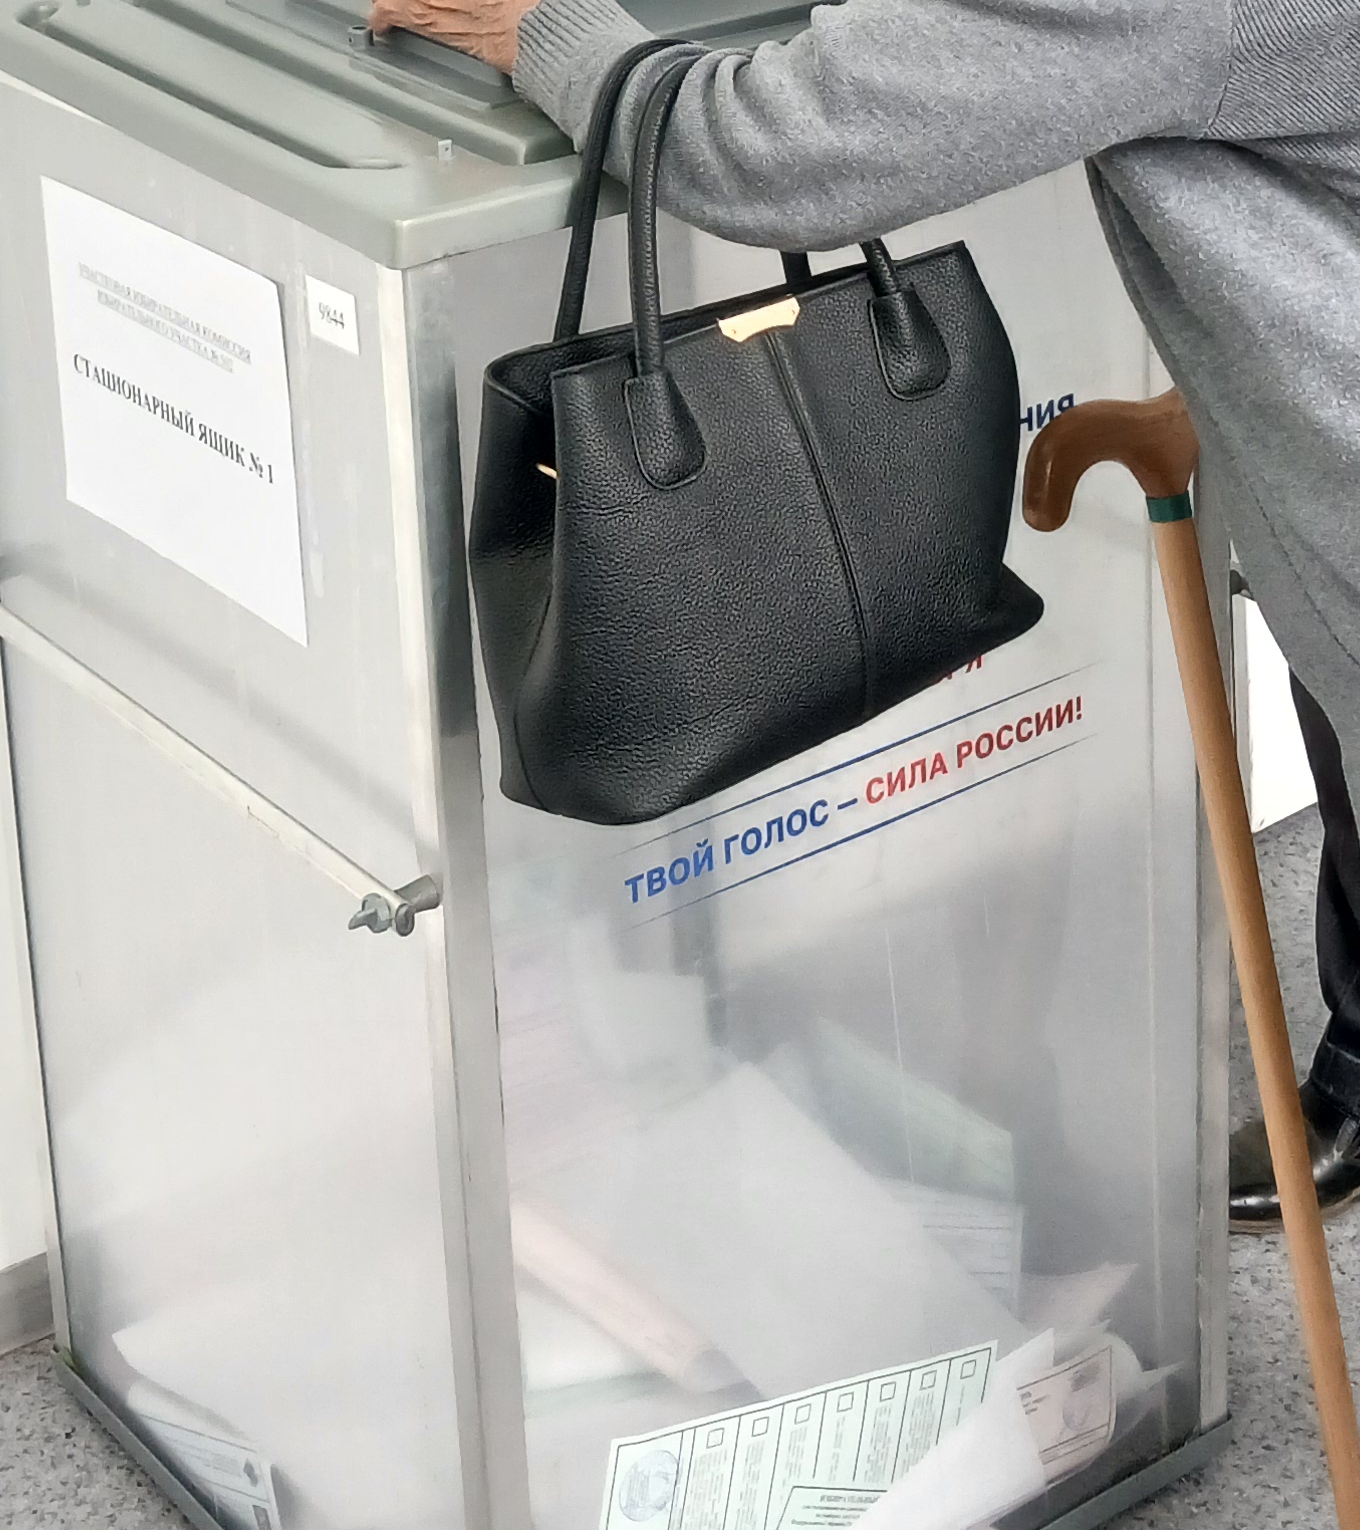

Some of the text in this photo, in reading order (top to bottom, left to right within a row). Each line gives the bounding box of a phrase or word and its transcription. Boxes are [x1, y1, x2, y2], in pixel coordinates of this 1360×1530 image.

[73, 353, 274, 484] СТАЦИОНАРНЫЙ ЯЩИК № 1
[624, 839, 714, 904] ТВОЙ
[723, 799, 829, 865] ГОЛОС
[864, 752, 948, 805] СИЛА
[956, 696, 1083, 769] РОССИИ!
